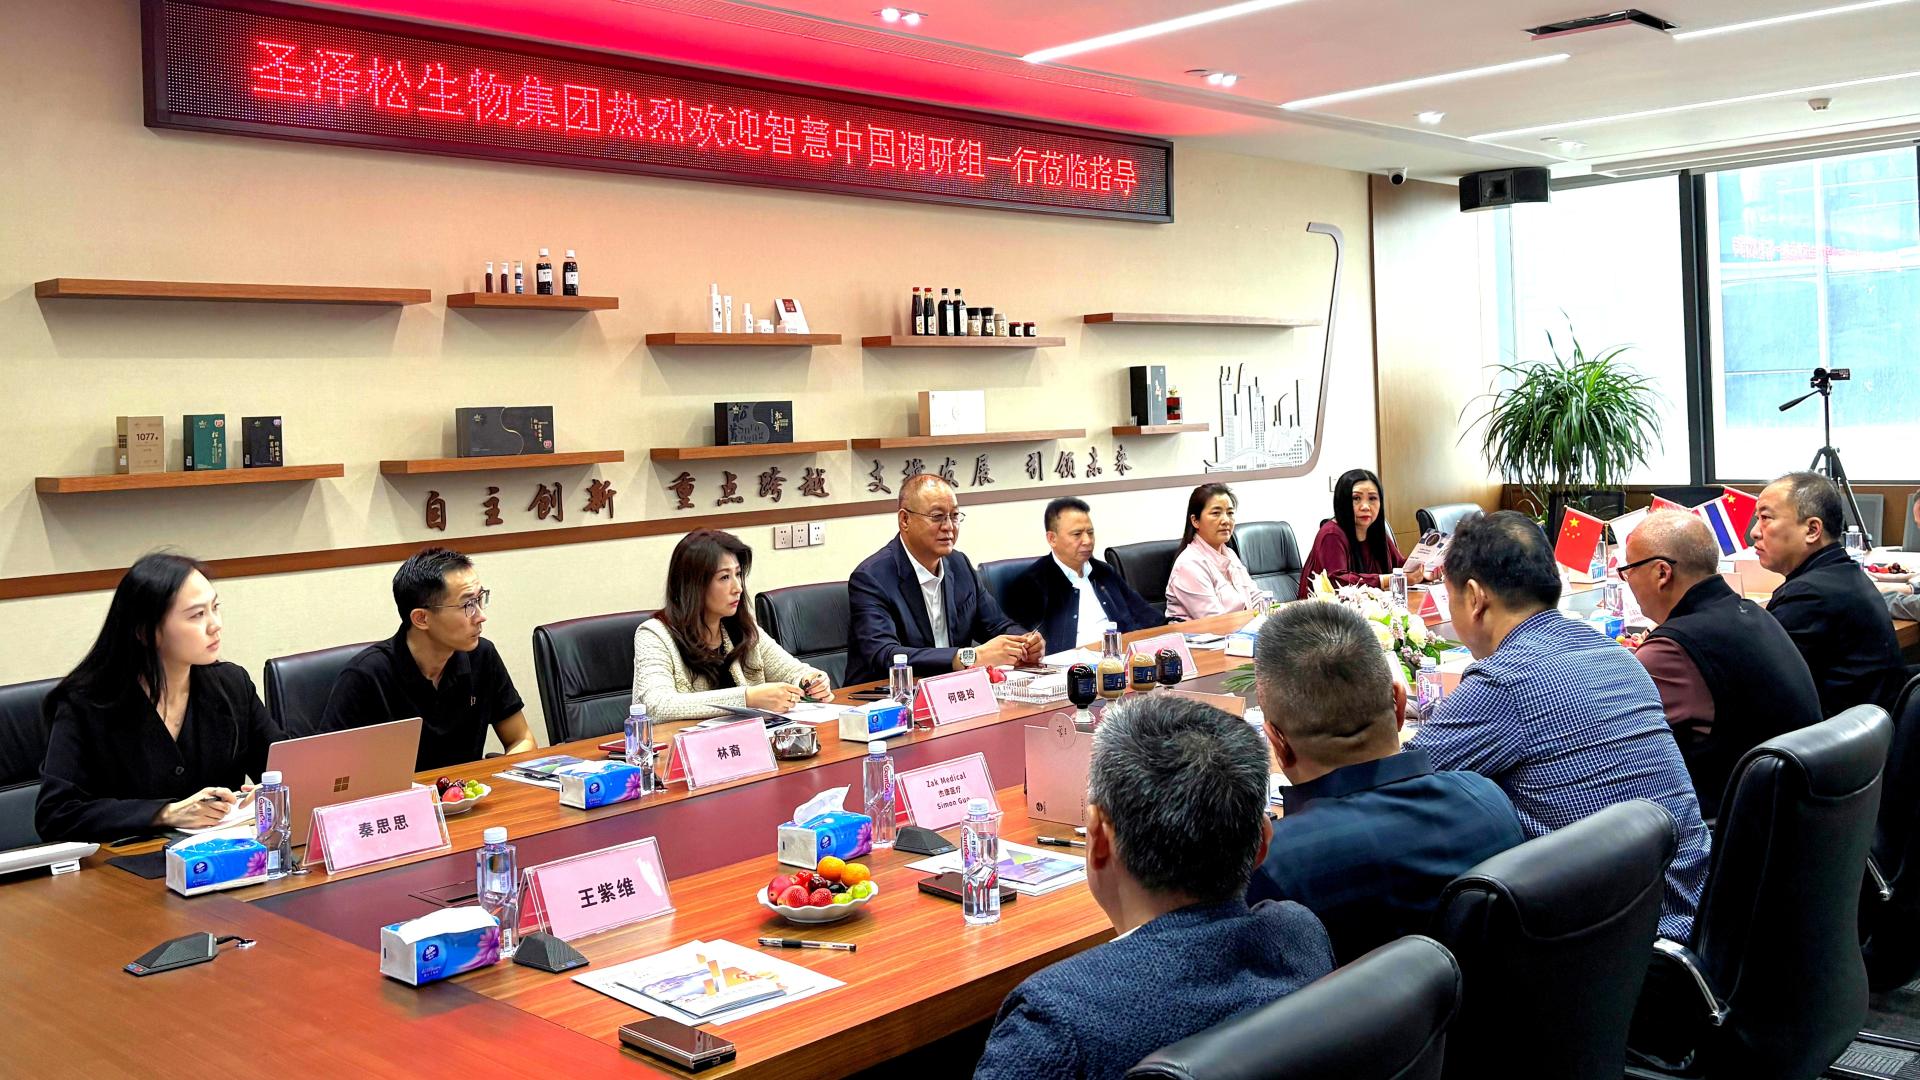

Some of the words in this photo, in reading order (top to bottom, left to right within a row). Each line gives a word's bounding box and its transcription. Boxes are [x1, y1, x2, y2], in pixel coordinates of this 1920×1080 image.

[252, 40, 1138, 197] 圣泽松生物集团热烈欢迎智慧中国调研组一行莅临指导
[136, 432, 155, 441] 1077
[424, 478, 617, 531] 自主创新
[667, 466, 831, 511] 重点跨越
[1024, 444, 1133, 482] 引领未来
[926, 779, 940, 788] Zak
[940, 771, 967, 785] Medical
[937, 800, 957, 810] Simon
[358, 814, 409, 838] 秦思思
[578, 877, 636, 908] 王紫维
